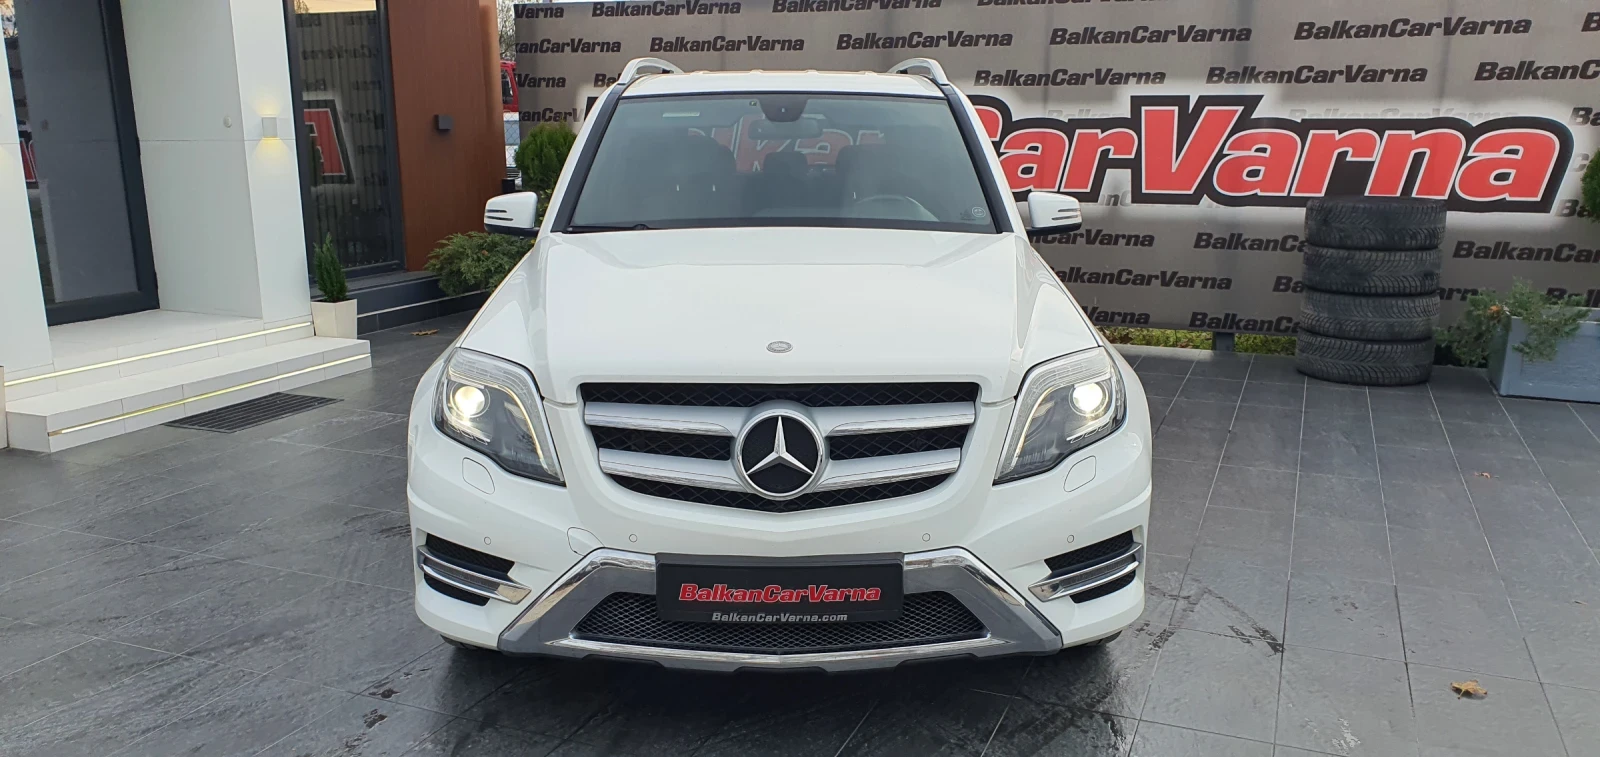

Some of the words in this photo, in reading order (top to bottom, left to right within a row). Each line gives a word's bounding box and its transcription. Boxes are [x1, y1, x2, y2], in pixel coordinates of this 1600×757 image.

[592, 1, 741, 17] BalkanCarVarna
[1049, 25, 1252, 46] BalkanCarVarna
[1294, 16, 1532, 40] BalkanCarVarna
[650, 36, 805, 53] BalkanCarVarna
[836, 31, 1013, 50] BalkanCarVarna
[973, 68, 1166, 87] BalkanCarVarna
[1206, 64, 1428, 85] BalkanCarVarna
[1051, 267, 1233, 290] alkanCarVarna
[679, 583, 882, 603] BalkanCarVarna
[712, 612, 848, 623] BalkanCarVarna.com
